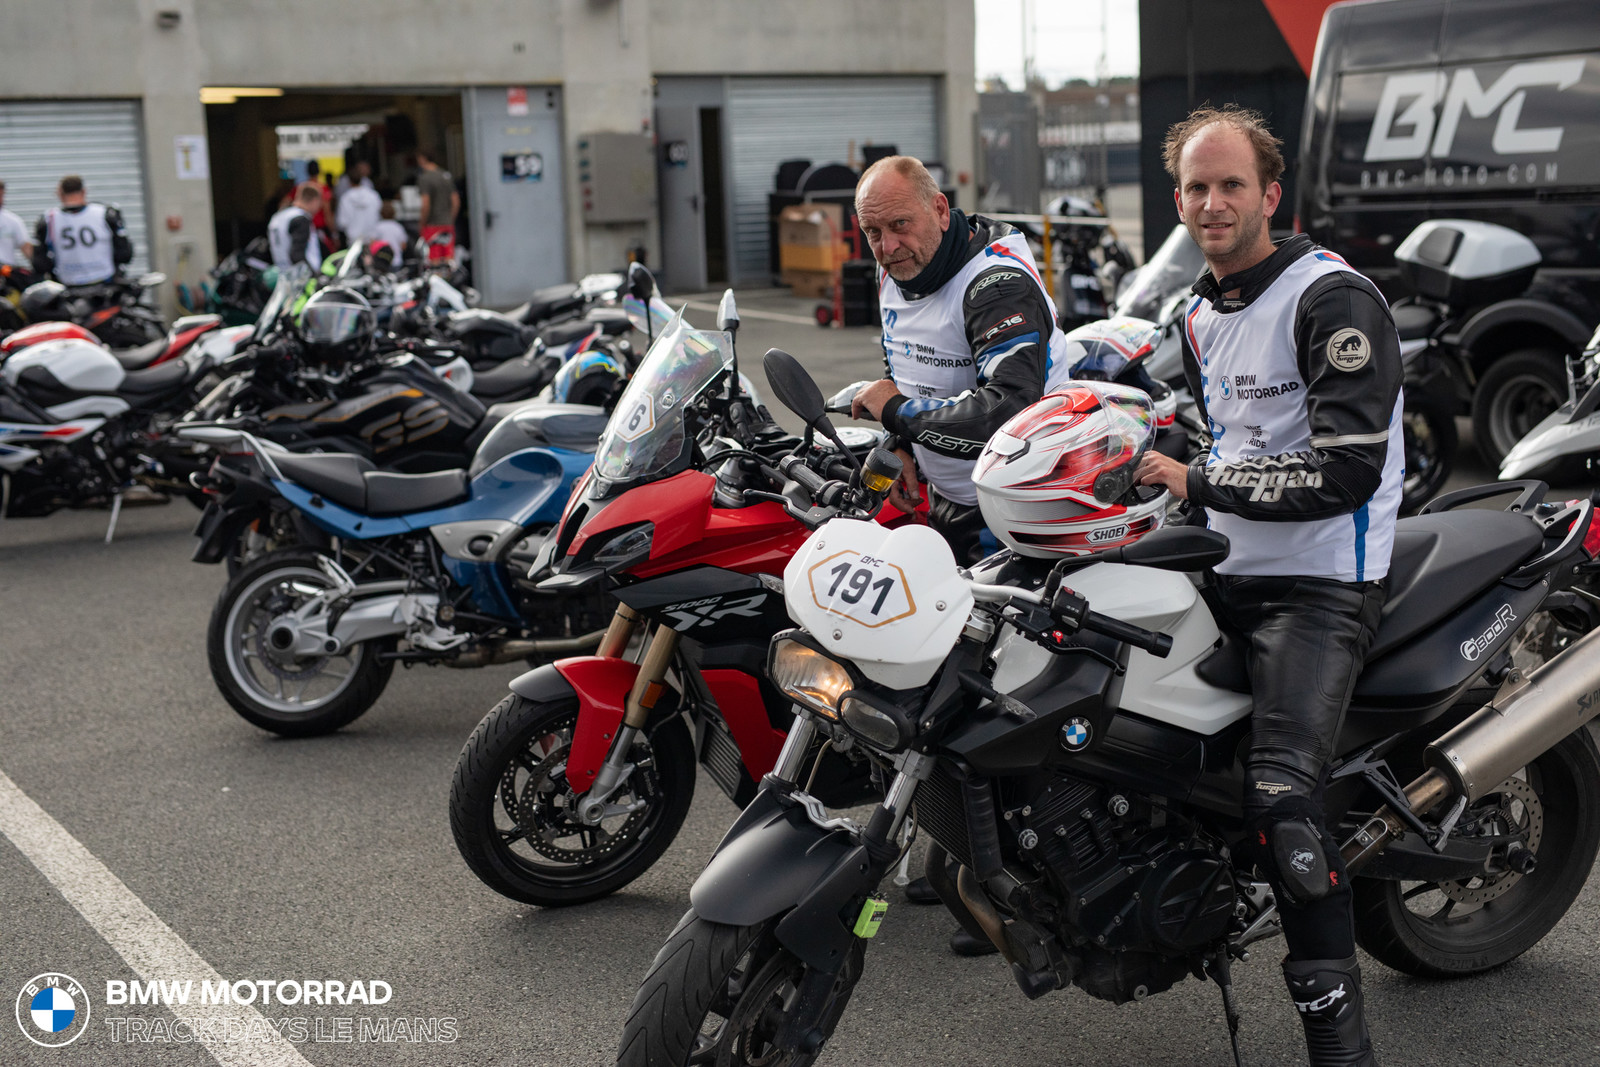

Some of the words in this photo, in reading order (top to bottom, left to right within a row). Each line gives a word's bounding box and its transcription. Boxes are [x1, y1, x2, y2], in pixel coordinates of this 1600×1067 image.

[1363, 58, 1586, 163] BMC
[515, 155, 540, 176] 59
[61, 226, 97, 250] 50
[969, 271, 1022, 300] RST
[985, 315, 1023, 340] R-16
[915, 343, 935, 355] BMW
[916, 354, 972, 368] MOTORRAD
[1235, 374, 1257, 387] BMW
[1236, 381, 1300, 400] MOTORRAD
[360, 400, 450, 454] GS
[917, 430, 987, 453] RST
[1092, 526, 1126, 541] SHOEI
[860, 555, 885, 568] BMC
[827, 562, 896, 616] 191
[660, 596, 723, 613] S1000
[665, 593, 768, 632] XR
[1062, 718, 1090, 732] BMW
[1294, 983, 1347, 1012] TCX
